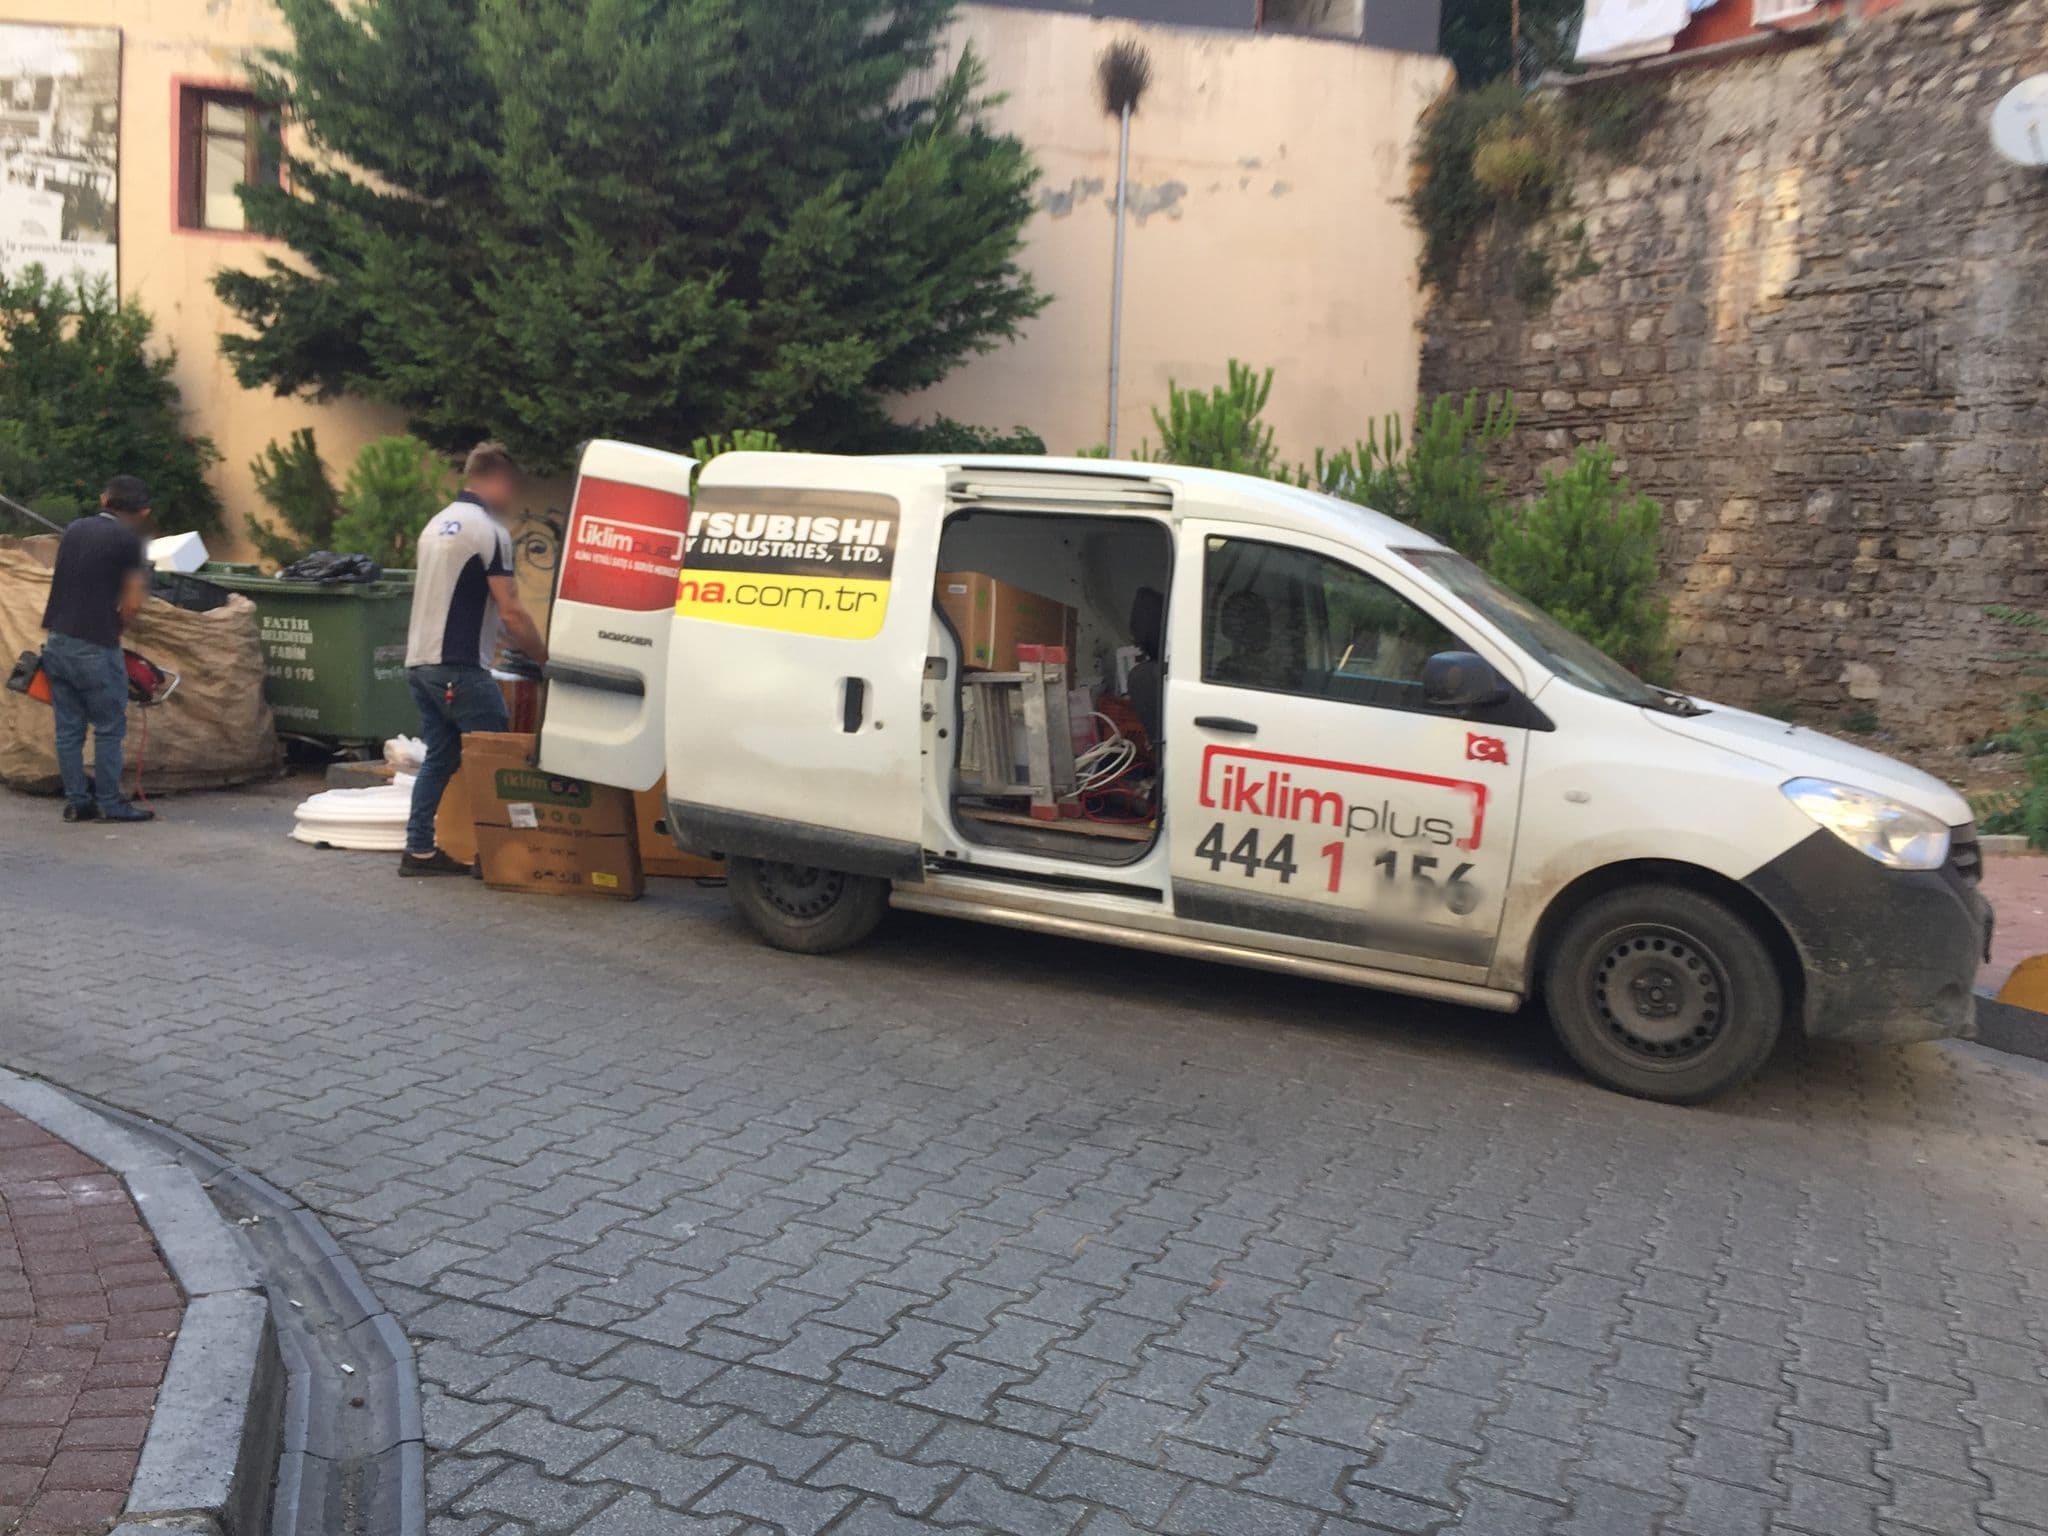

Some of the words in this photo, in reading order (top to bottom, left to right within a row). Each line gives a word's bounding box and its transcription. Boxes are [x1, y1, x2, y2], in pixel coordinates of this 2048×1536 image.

[703, 538, 834, 563] INDUSTRIES,
[841, 546, 884, 563] LTD.
[263, 615, 310, 631] FATİH
[1220, 763, 1455, 847] iklimplus
[1194, 822, 1298, 884] 444
[1320, 841, 1345, 893] 1
